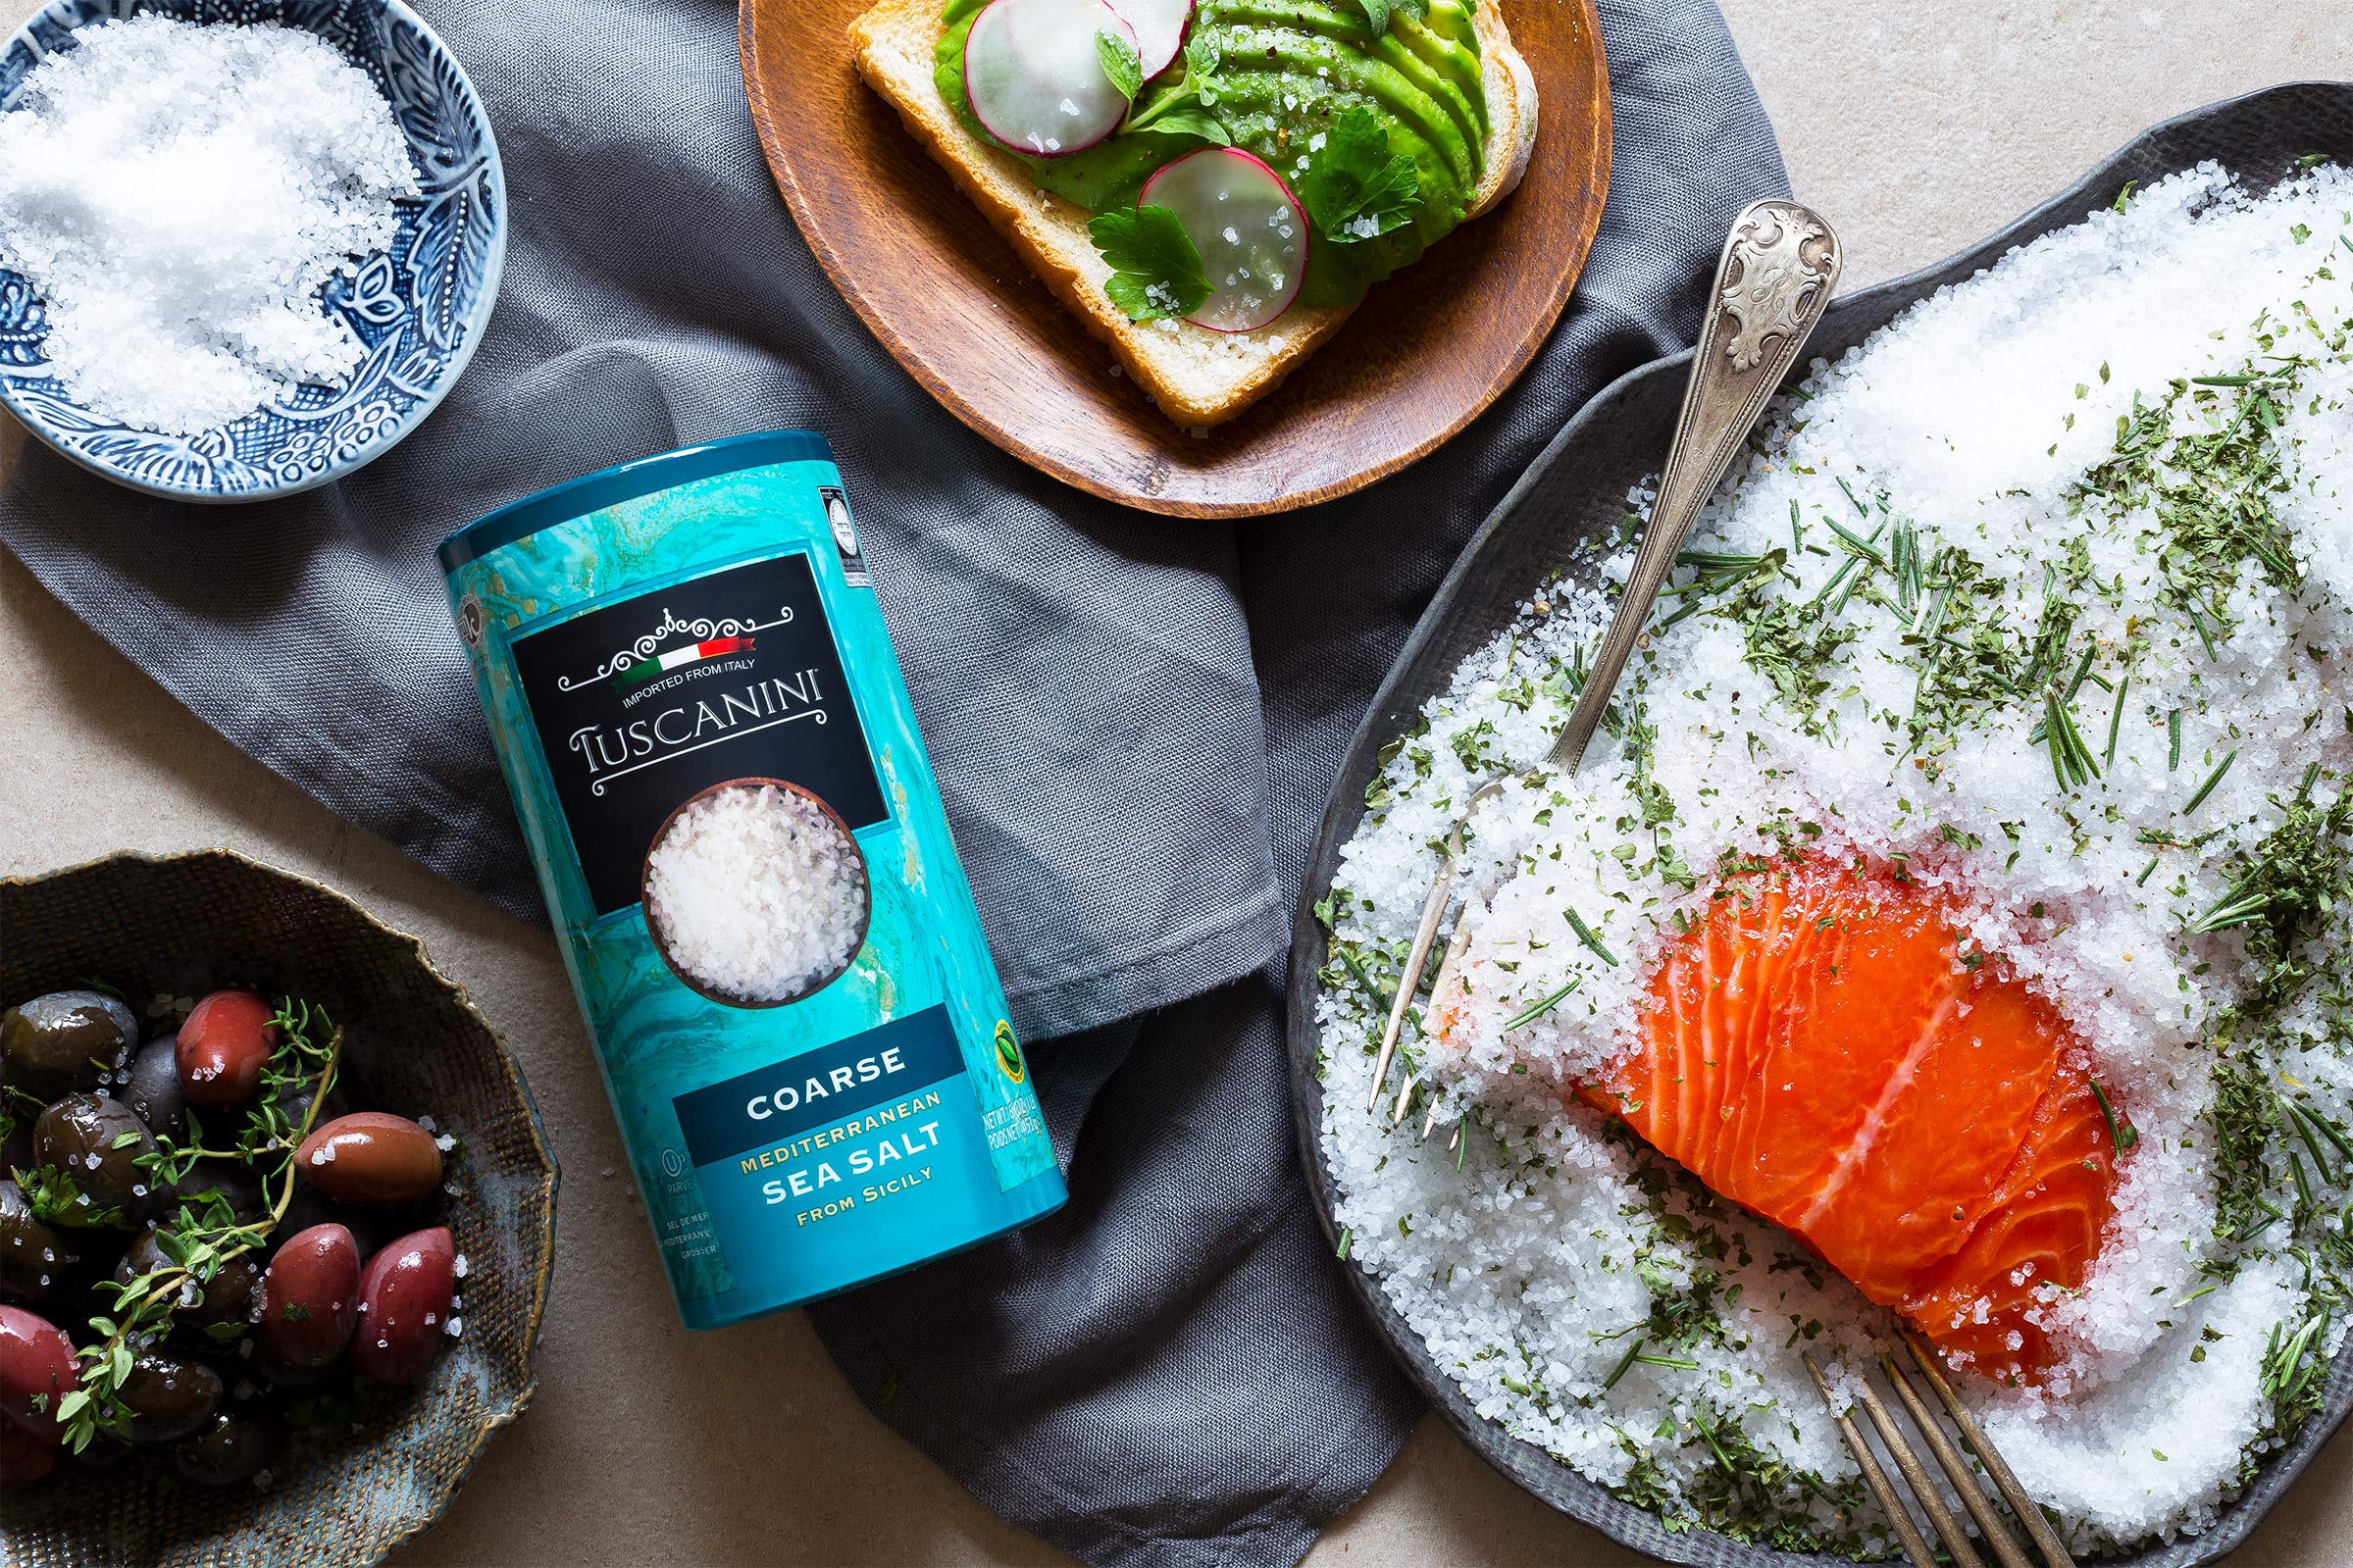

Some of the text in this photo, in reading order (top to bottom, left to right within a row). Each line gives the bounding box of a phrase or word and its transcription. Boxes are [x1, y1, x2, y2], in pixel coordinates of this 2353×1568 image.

[622, 658, 755, 709] IMPORTED FROM ITALY
[569, 669, 823, 774] TUSCANINI
[746, 1046, 905, 1120] COARSE
[740, 1090, 941, 1175] MEDITERRANEAN
[762, 1121, 940, 1205] SEA SALT
[668, 1179, 693, 1194] PARVE
[795, 1166, 933, 1227] FROM SICILY
[667, 1221, 680, 1231] SEL
[680, 1217, 691, 1227] DE
